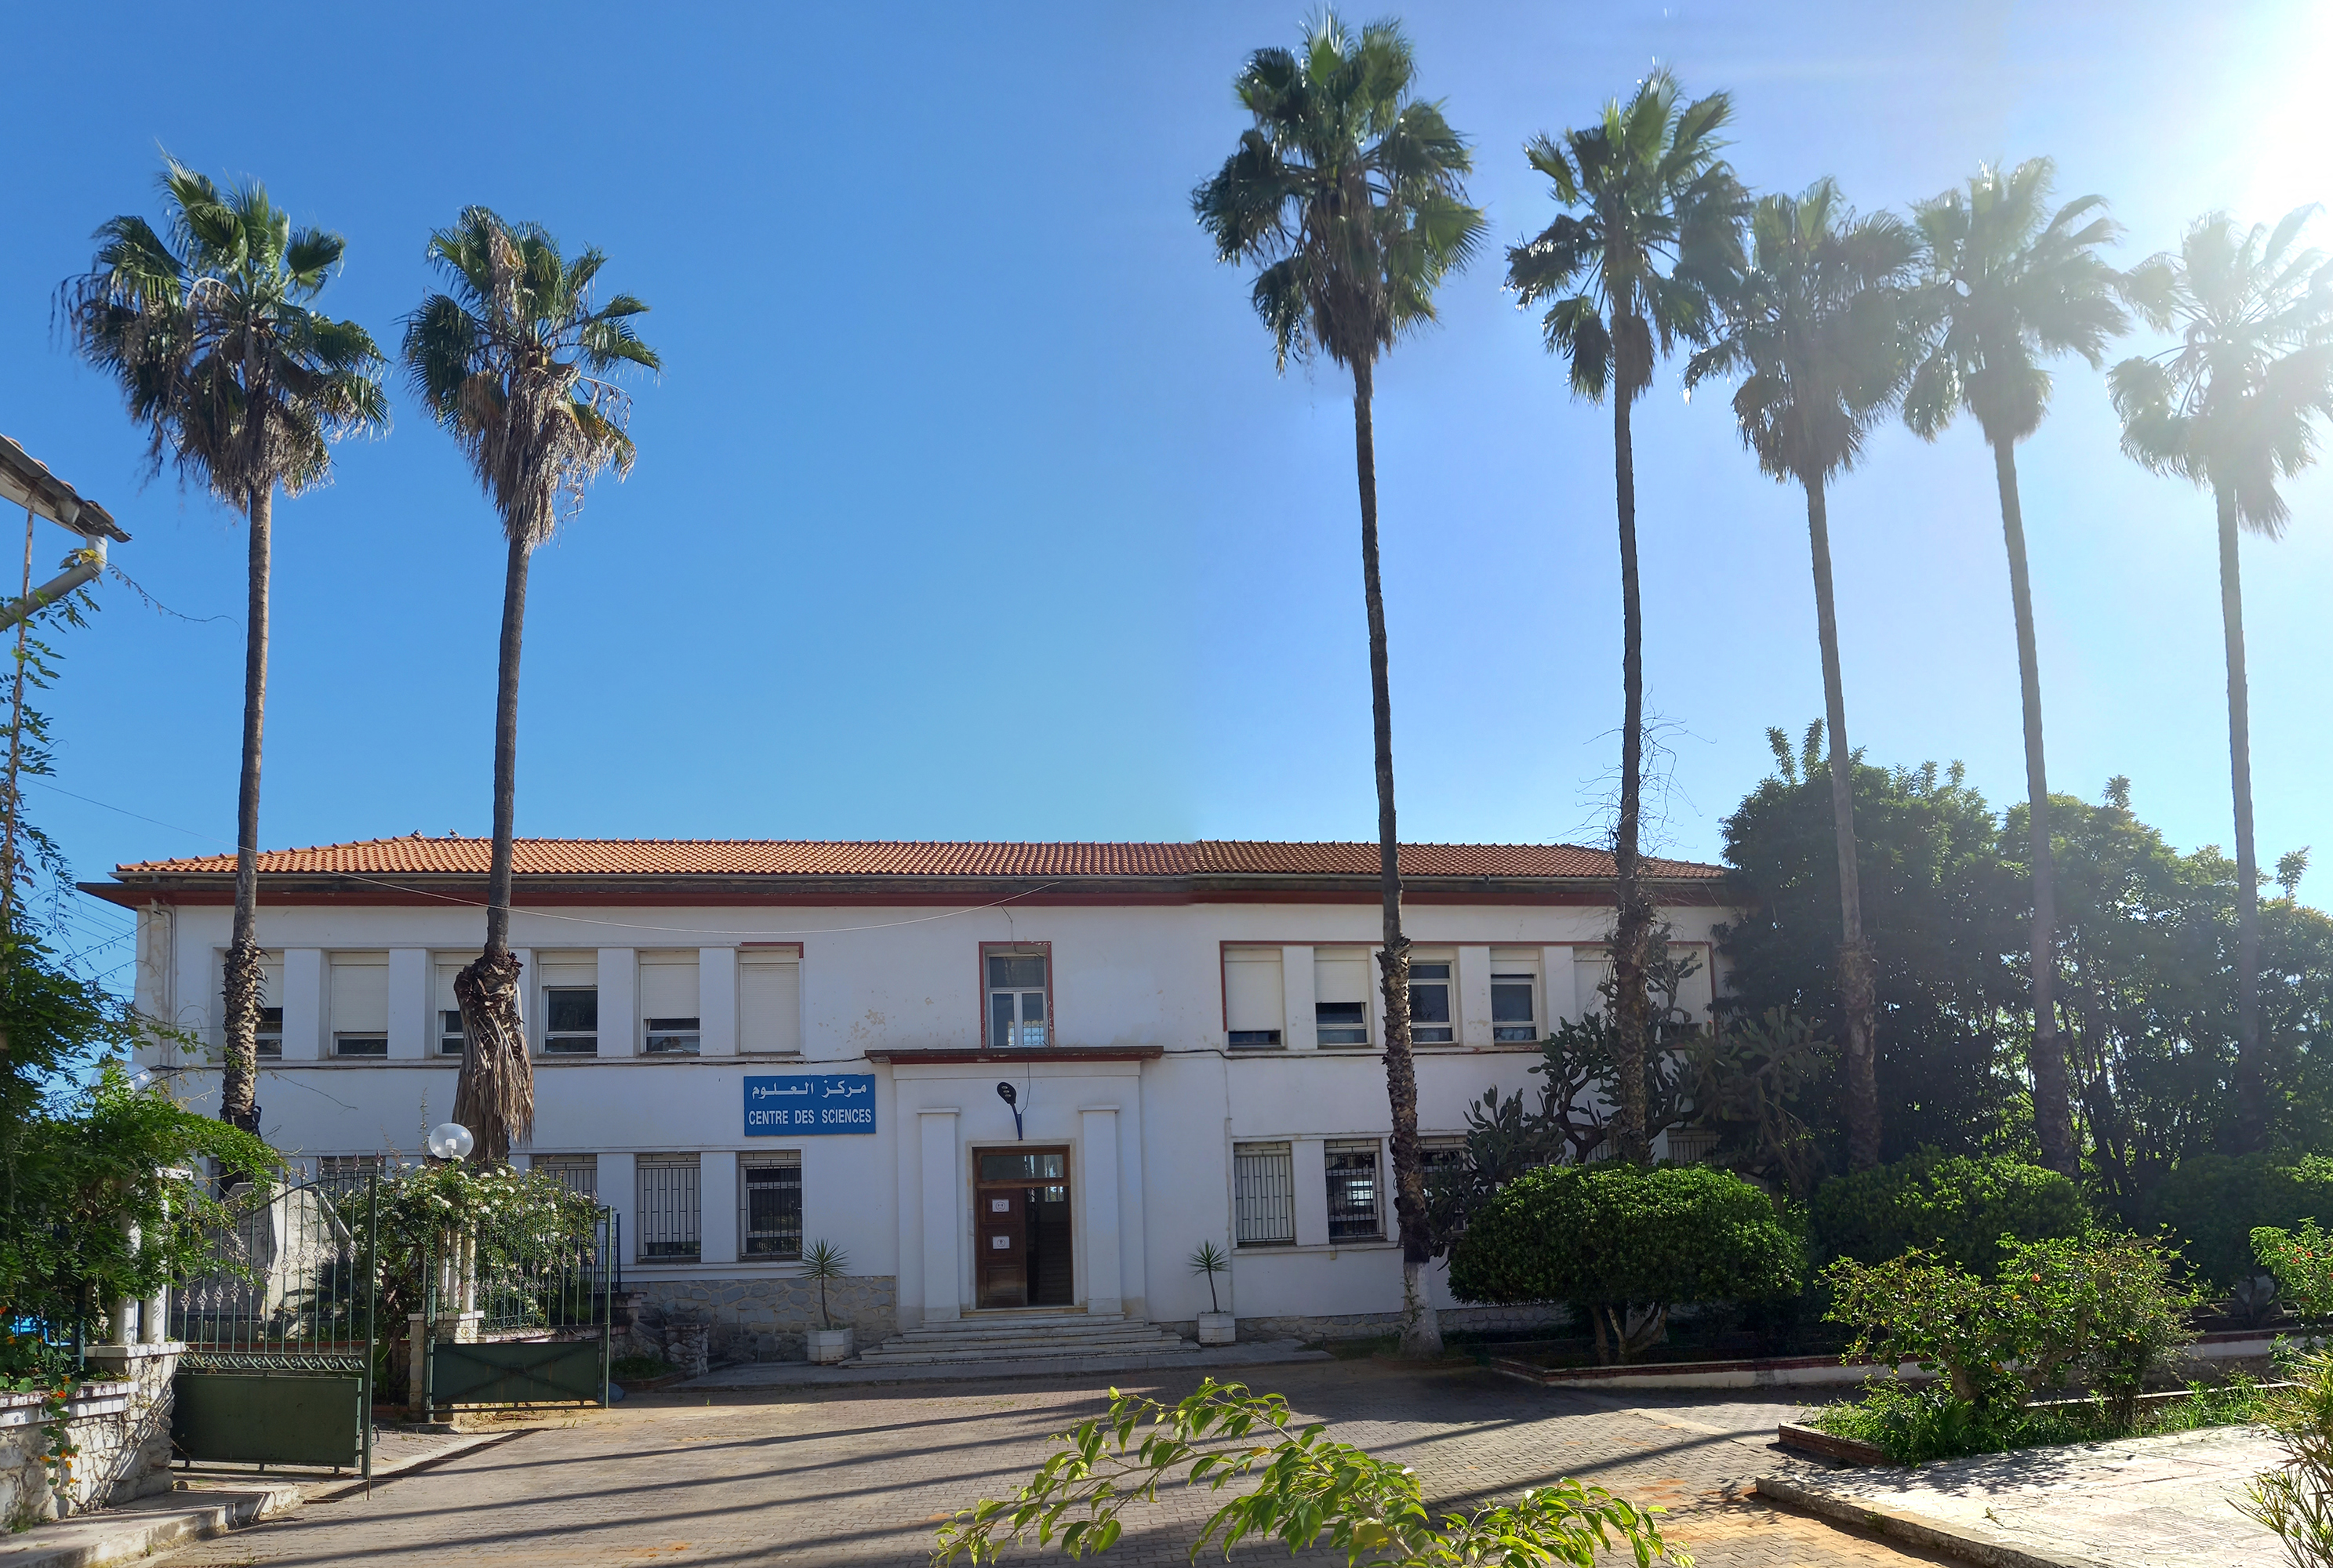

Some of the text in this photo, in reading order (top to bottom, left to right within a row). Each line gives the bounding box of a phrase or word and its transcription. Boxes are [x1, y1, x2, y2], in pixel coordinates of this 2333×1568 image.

[752, 1079, 867, 1099] مركز العلوم
[748, 1109, 871, 1125] CENTRE DES SCIENCES
